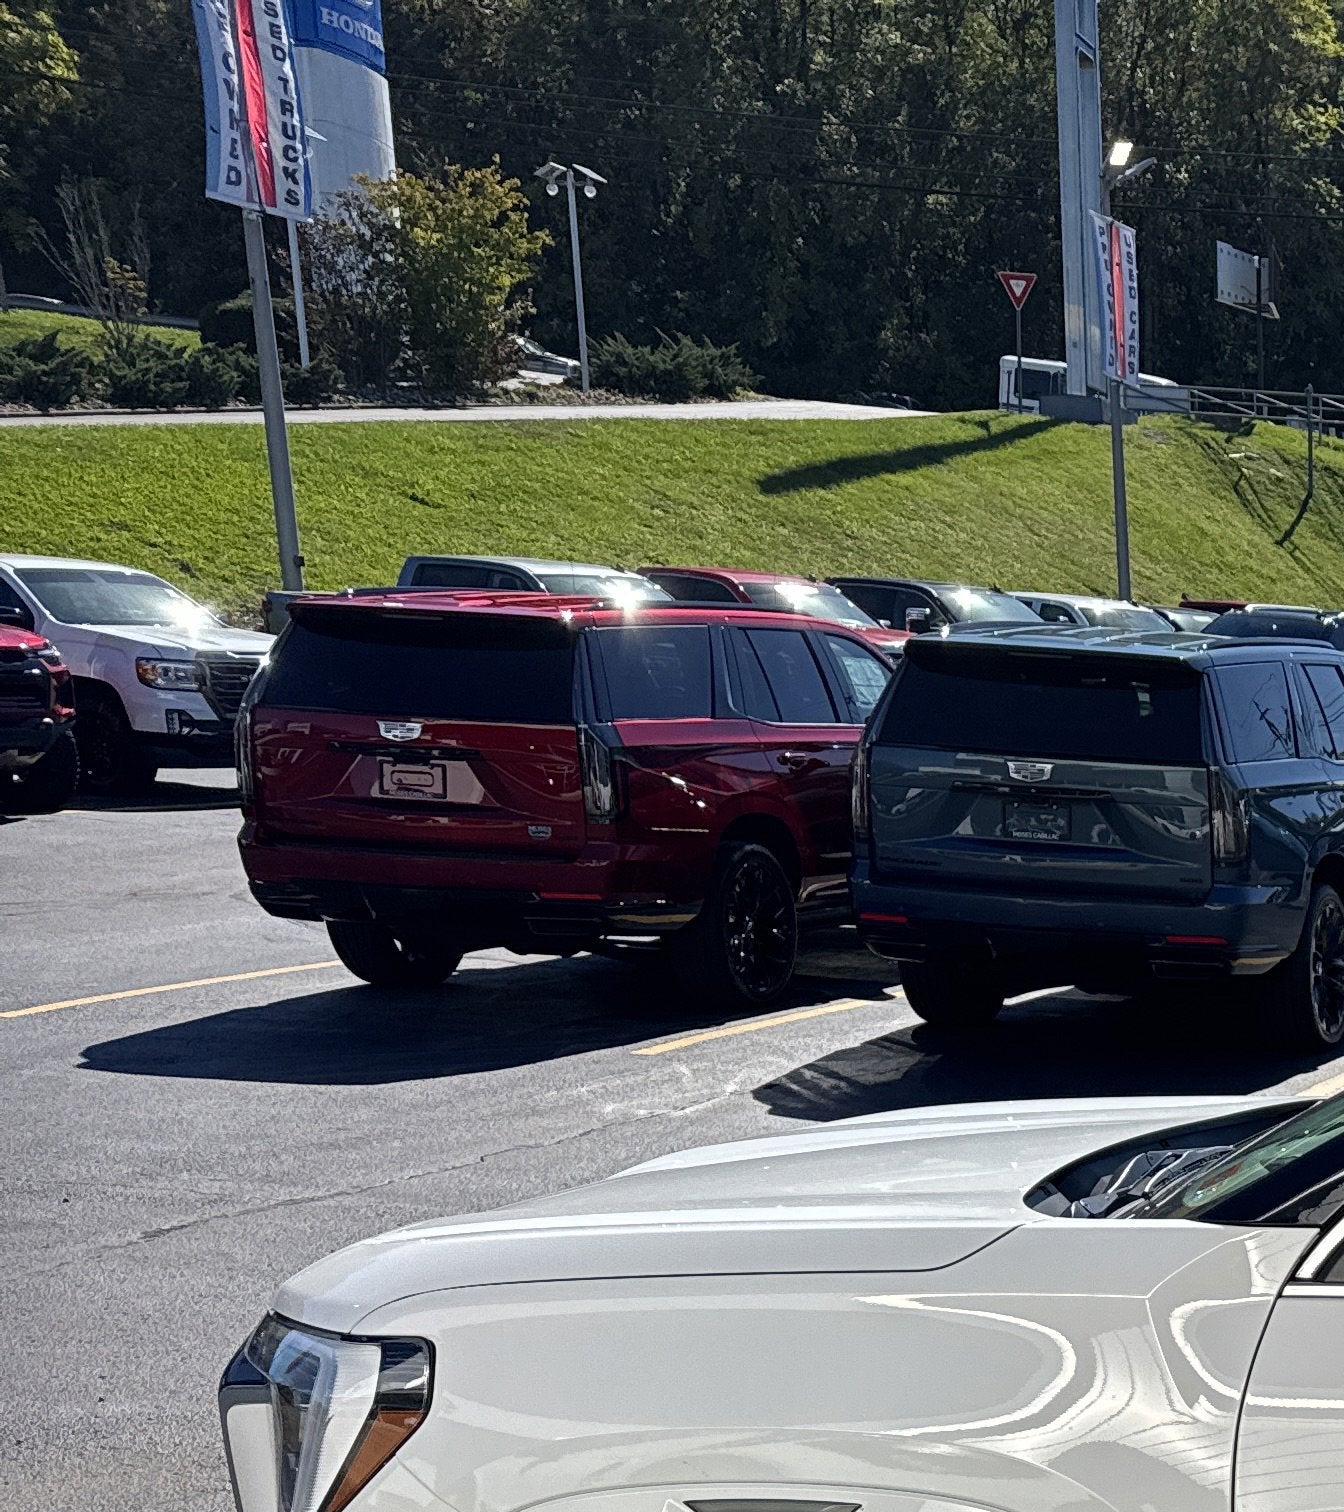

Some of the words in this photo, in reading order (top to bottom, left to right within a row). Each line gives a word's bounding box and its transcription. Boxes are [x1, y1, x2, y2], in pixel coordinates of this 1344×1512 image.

[278, 75, 300, 207] TRUCKS
[1123, 233, 1136, 300] USED
[1128, 311, 1137, 375] CARS
